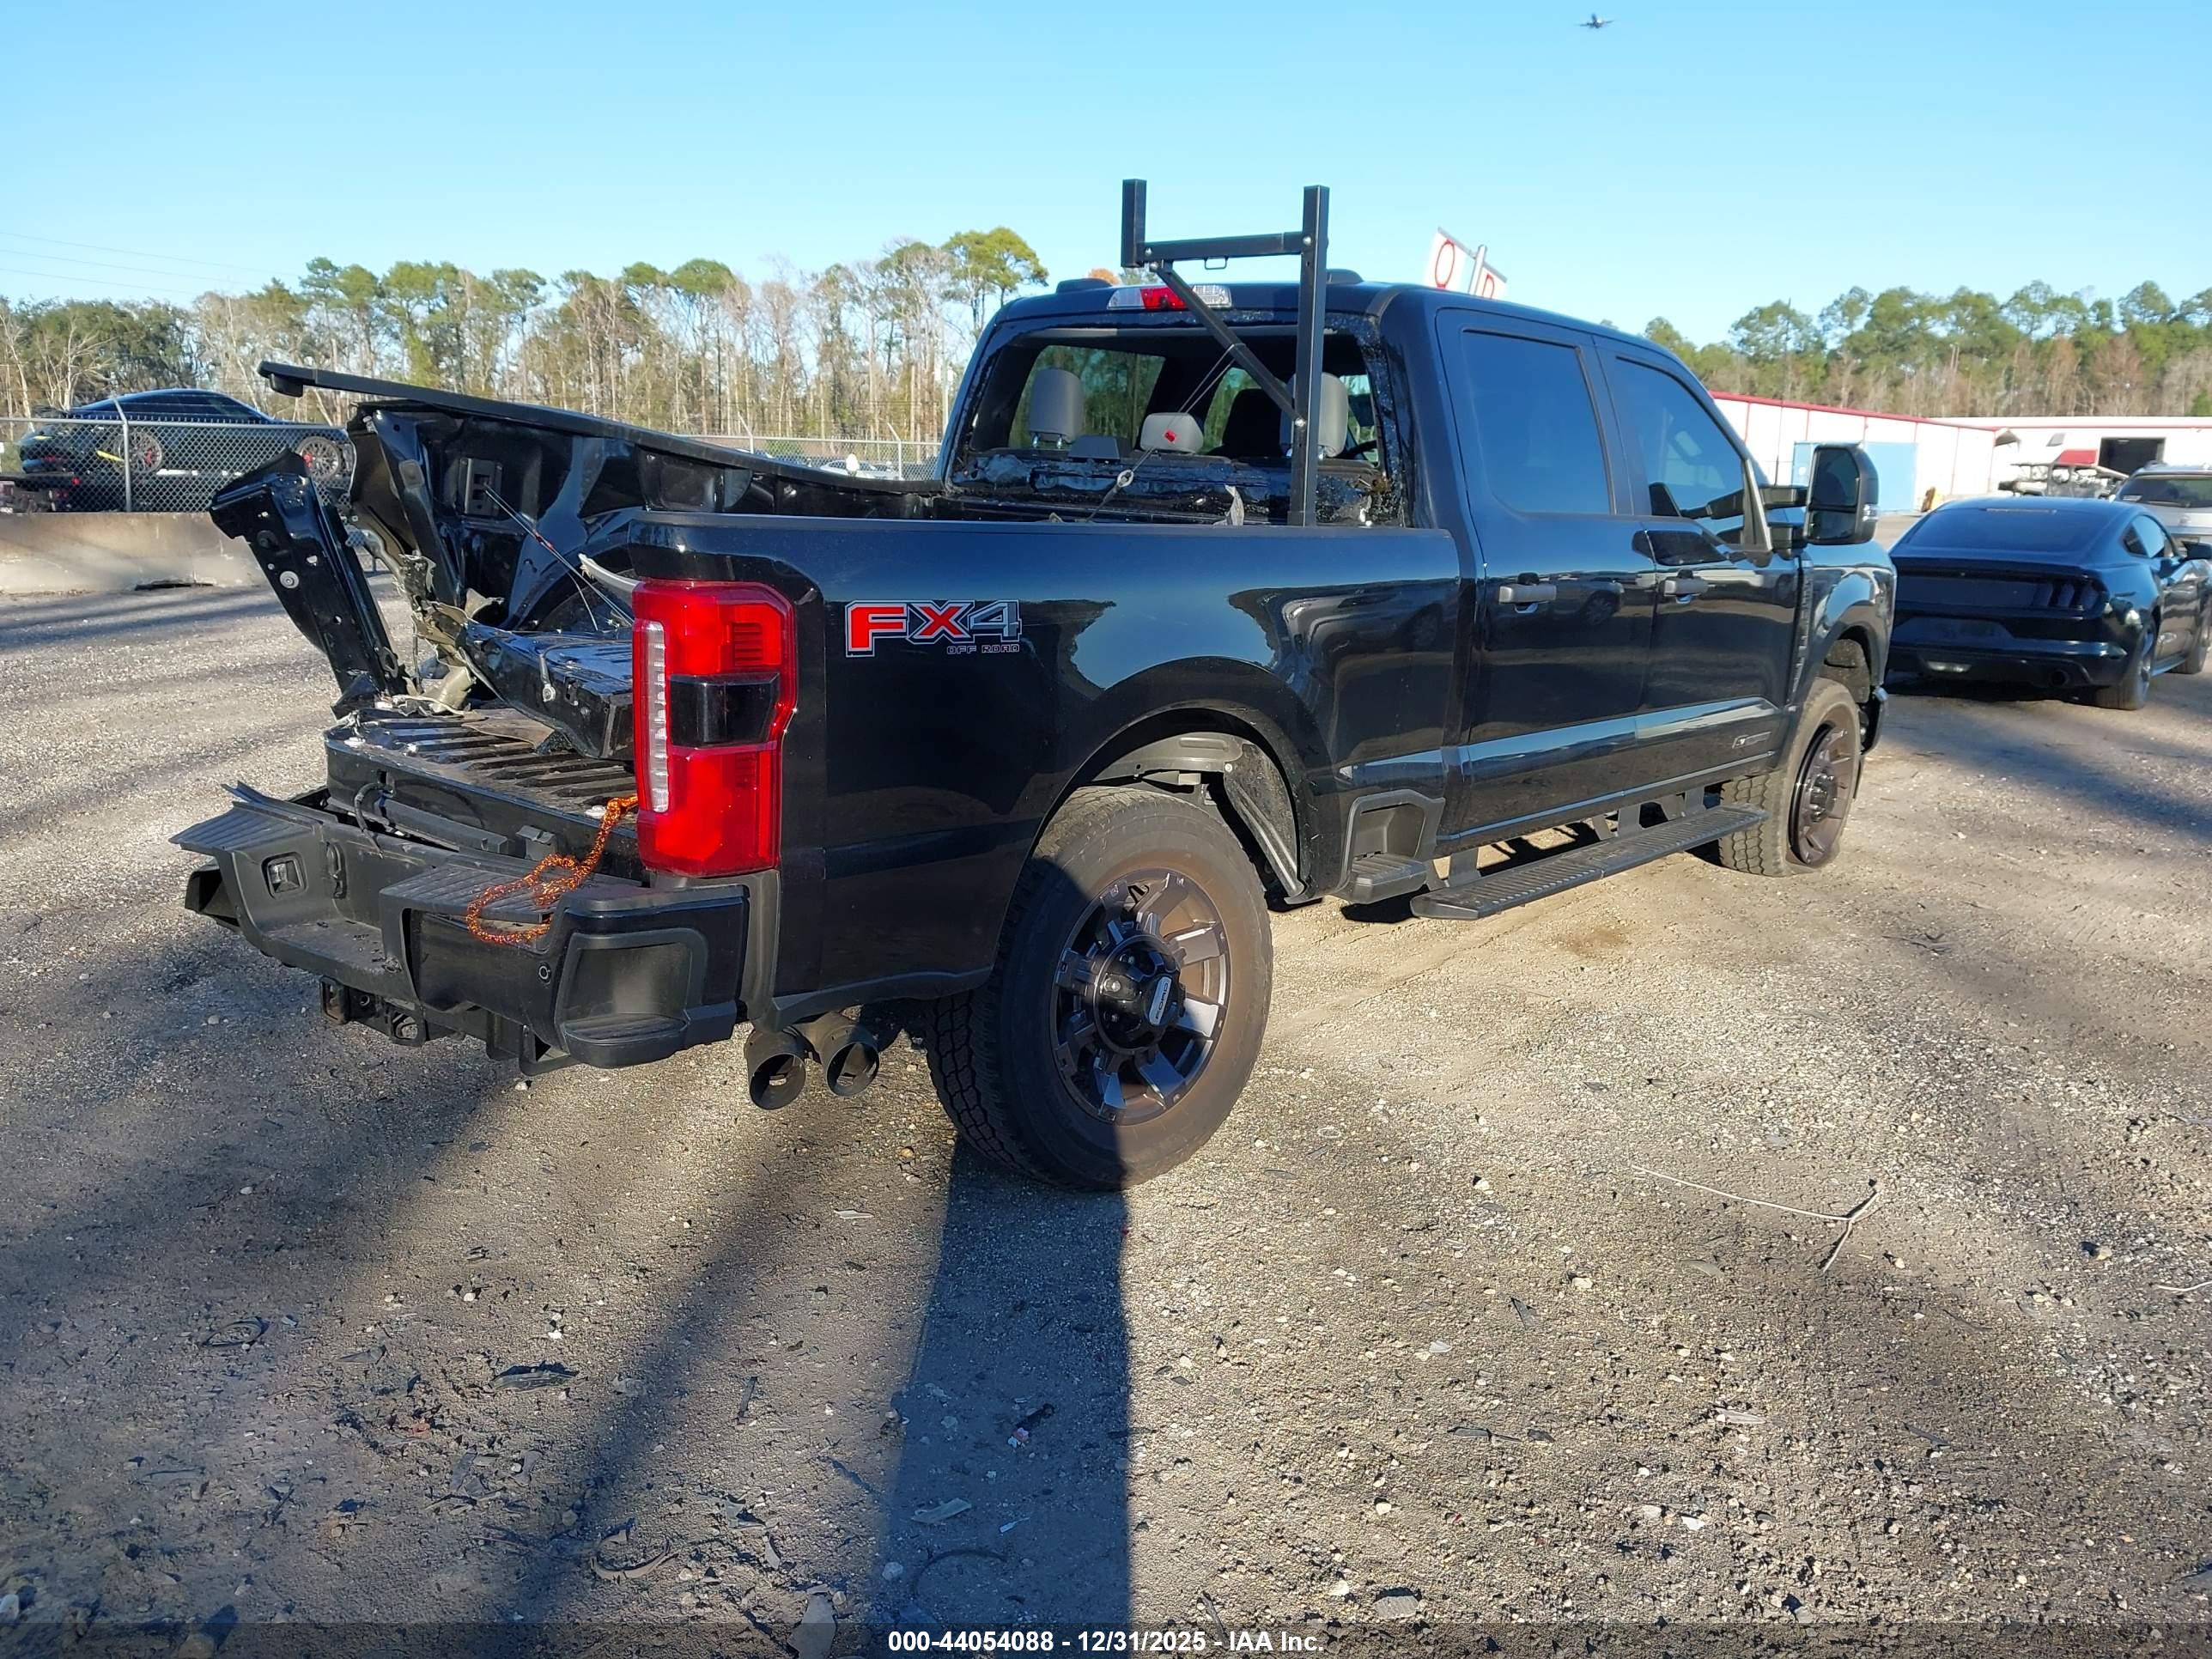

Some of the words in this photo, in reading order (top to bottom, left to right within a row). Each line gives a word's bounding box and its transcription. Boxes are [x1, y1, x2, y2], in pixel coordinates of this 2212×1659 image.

[845, 599, 1022, 657] FX4
[946, 644, 977, 655] OFF
[981, 643, 1020, 653] ROAD
